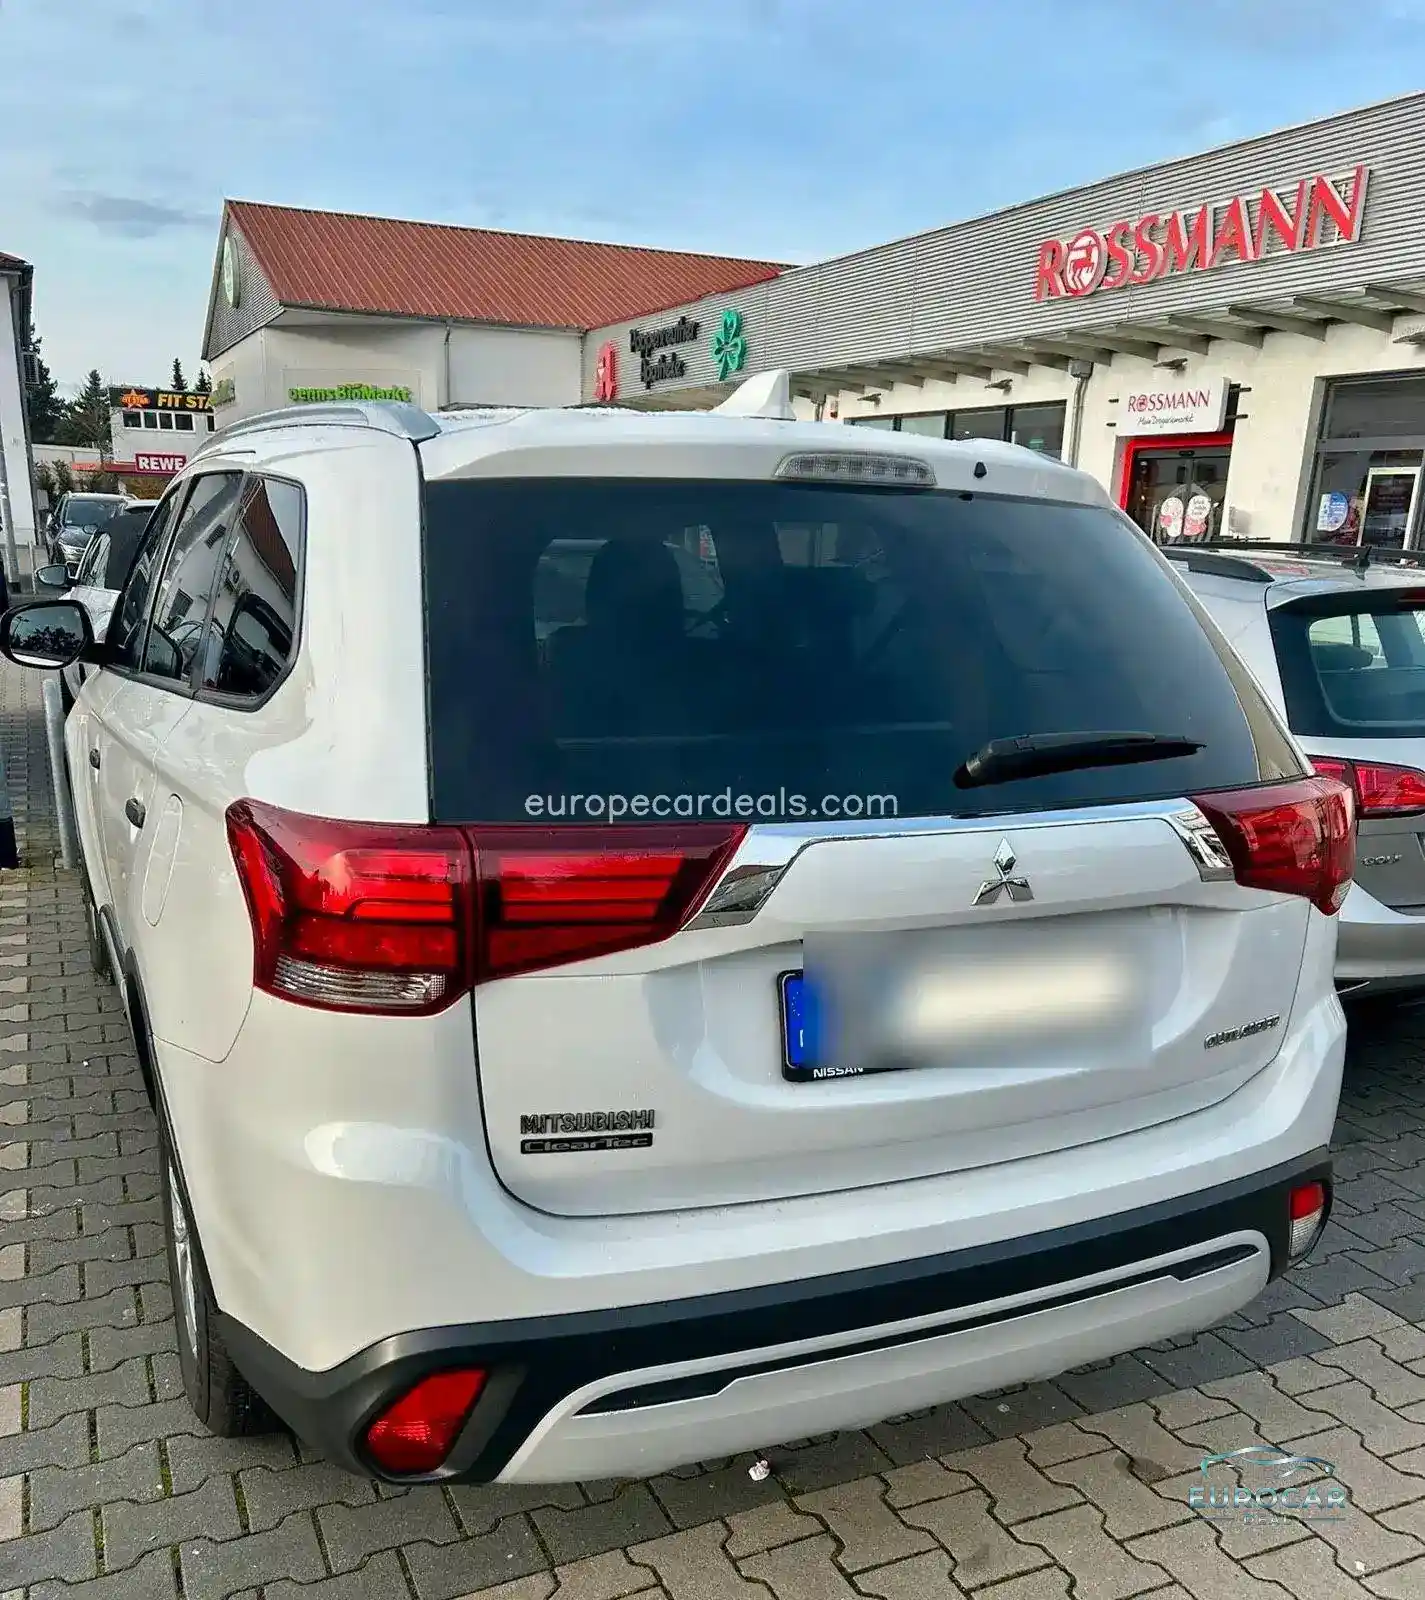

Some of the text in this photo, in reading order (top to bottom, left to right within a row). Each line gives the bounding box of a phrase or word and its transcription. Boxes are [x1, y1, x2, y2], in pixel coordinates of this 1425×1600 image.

[1035, 164, 1370, 302] ROSSMANN
[157, 393, 183, 407] FIT
[1127, 389, 1211, 413] ROSSMANN
[138, 456, 185, 471] REWE
[520, 1109, 656, 1134] MITSUBISHI
